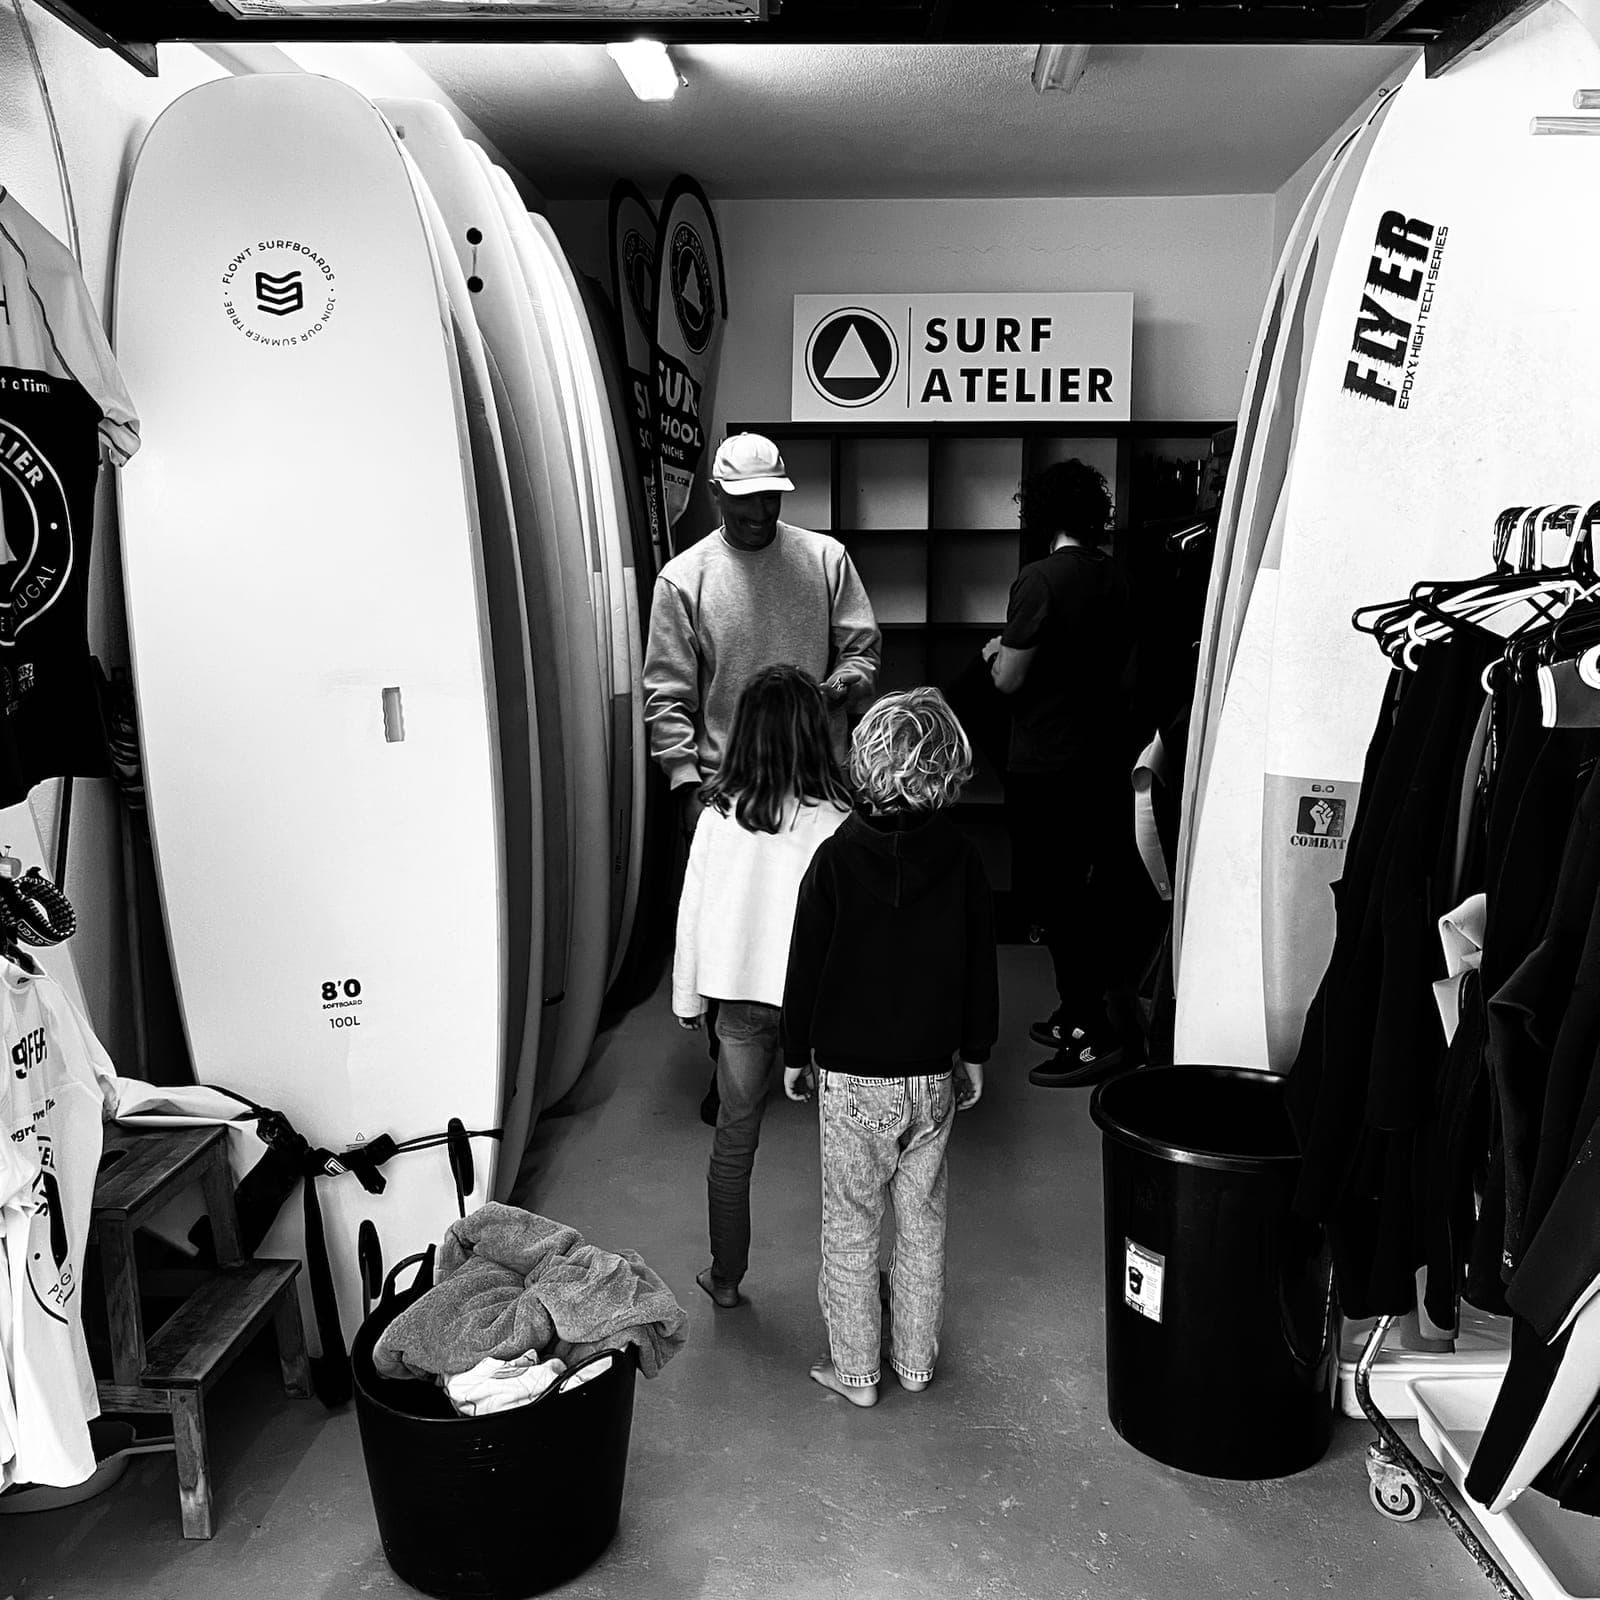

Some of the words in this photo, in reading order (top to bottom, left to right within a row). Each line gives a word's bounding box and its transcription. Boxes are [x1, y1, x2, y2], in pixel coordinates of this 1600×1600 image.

[222, 247, 253, 284] FLOWT
[258, 240, 335, 281] SURFBOARDS
[224, 301, 245, 331] TRIBE
[321, 297, 336, 322] JOIN
[1341, 210, 1435, 407] FLYER
[1398, 360, 1420, 409] EPOXY
[1410, 324, 1426, 358] HIGH
[1418, 282, 1436, 321] TECH
[1428, 226, 1449, 281] SERIES
[245, 330, 297, 346] SUMMER
[300, 323, 323, 341] OUR
[924, 317, 1053, 353] SURF
[658, 360, 698, 417] UR
[920, 367, 1114, 403] ATELIER
[1290, 835, 1346, 849] COMBAT
[321, 978, 361, 1001] 8'0
[322, 1000, 363, 1010] SOFTBOARD
[329, 1015, 361, 1029] 100L
